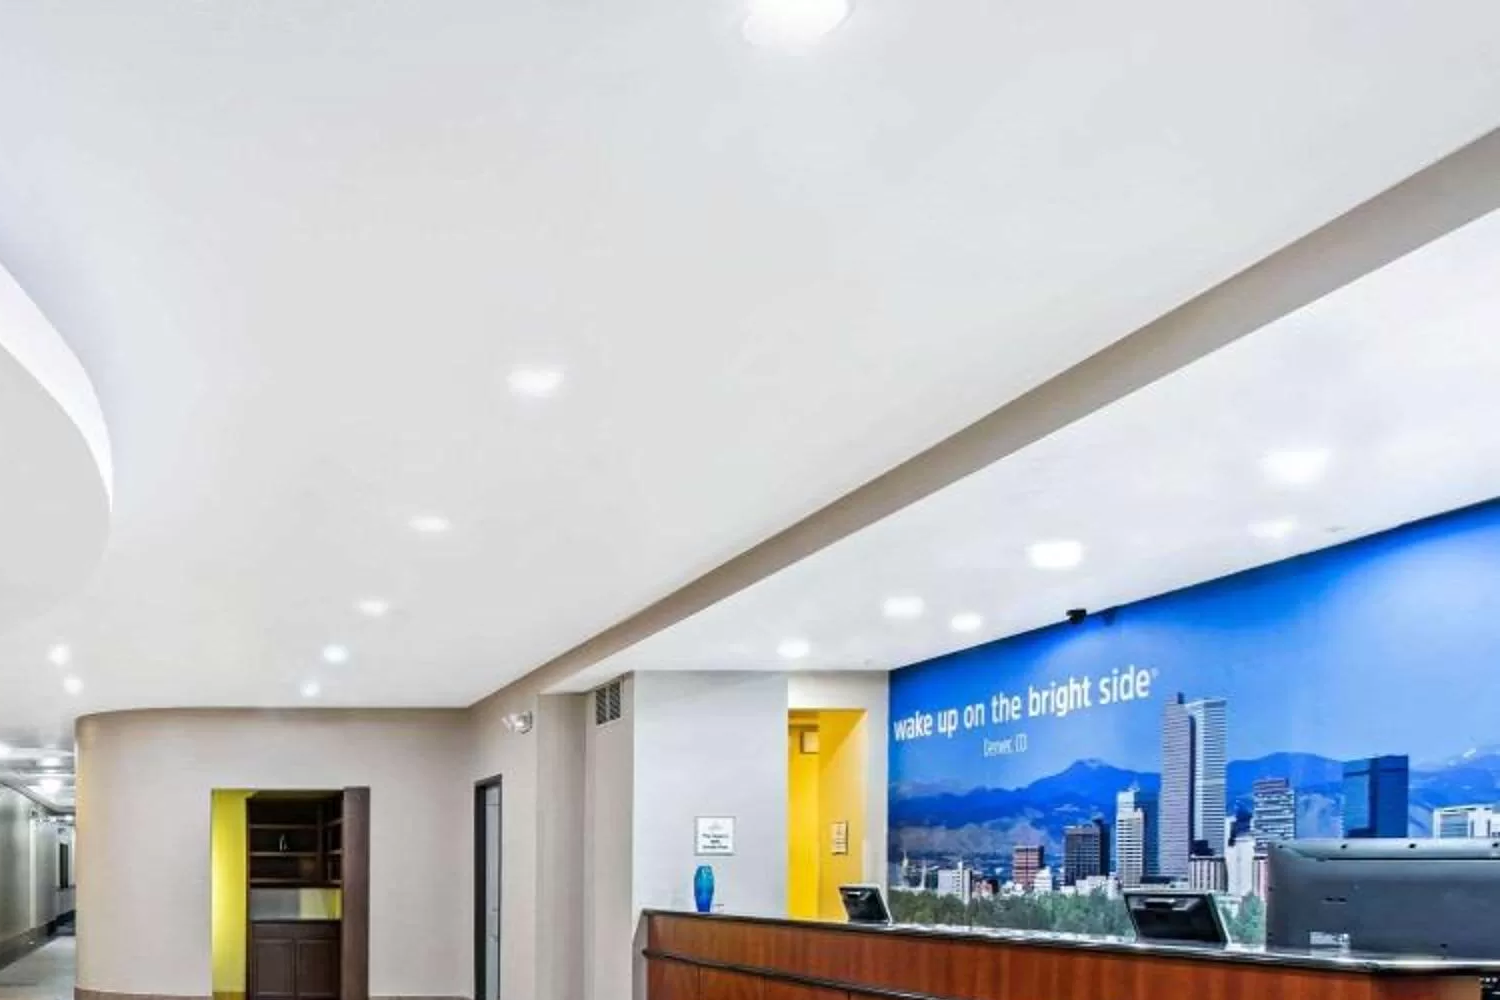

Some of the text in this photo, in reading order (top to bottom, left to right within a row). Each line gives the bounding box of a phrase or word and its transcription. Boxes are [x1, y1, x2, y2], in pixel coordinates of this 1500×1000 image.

[894, 711, 933, 741] wake
[938, 708, 959, 738] up
[963, 702, 985, 728] on
[991, 692, 1022, 724] the
[1028, 674, 1093, 718] bright
